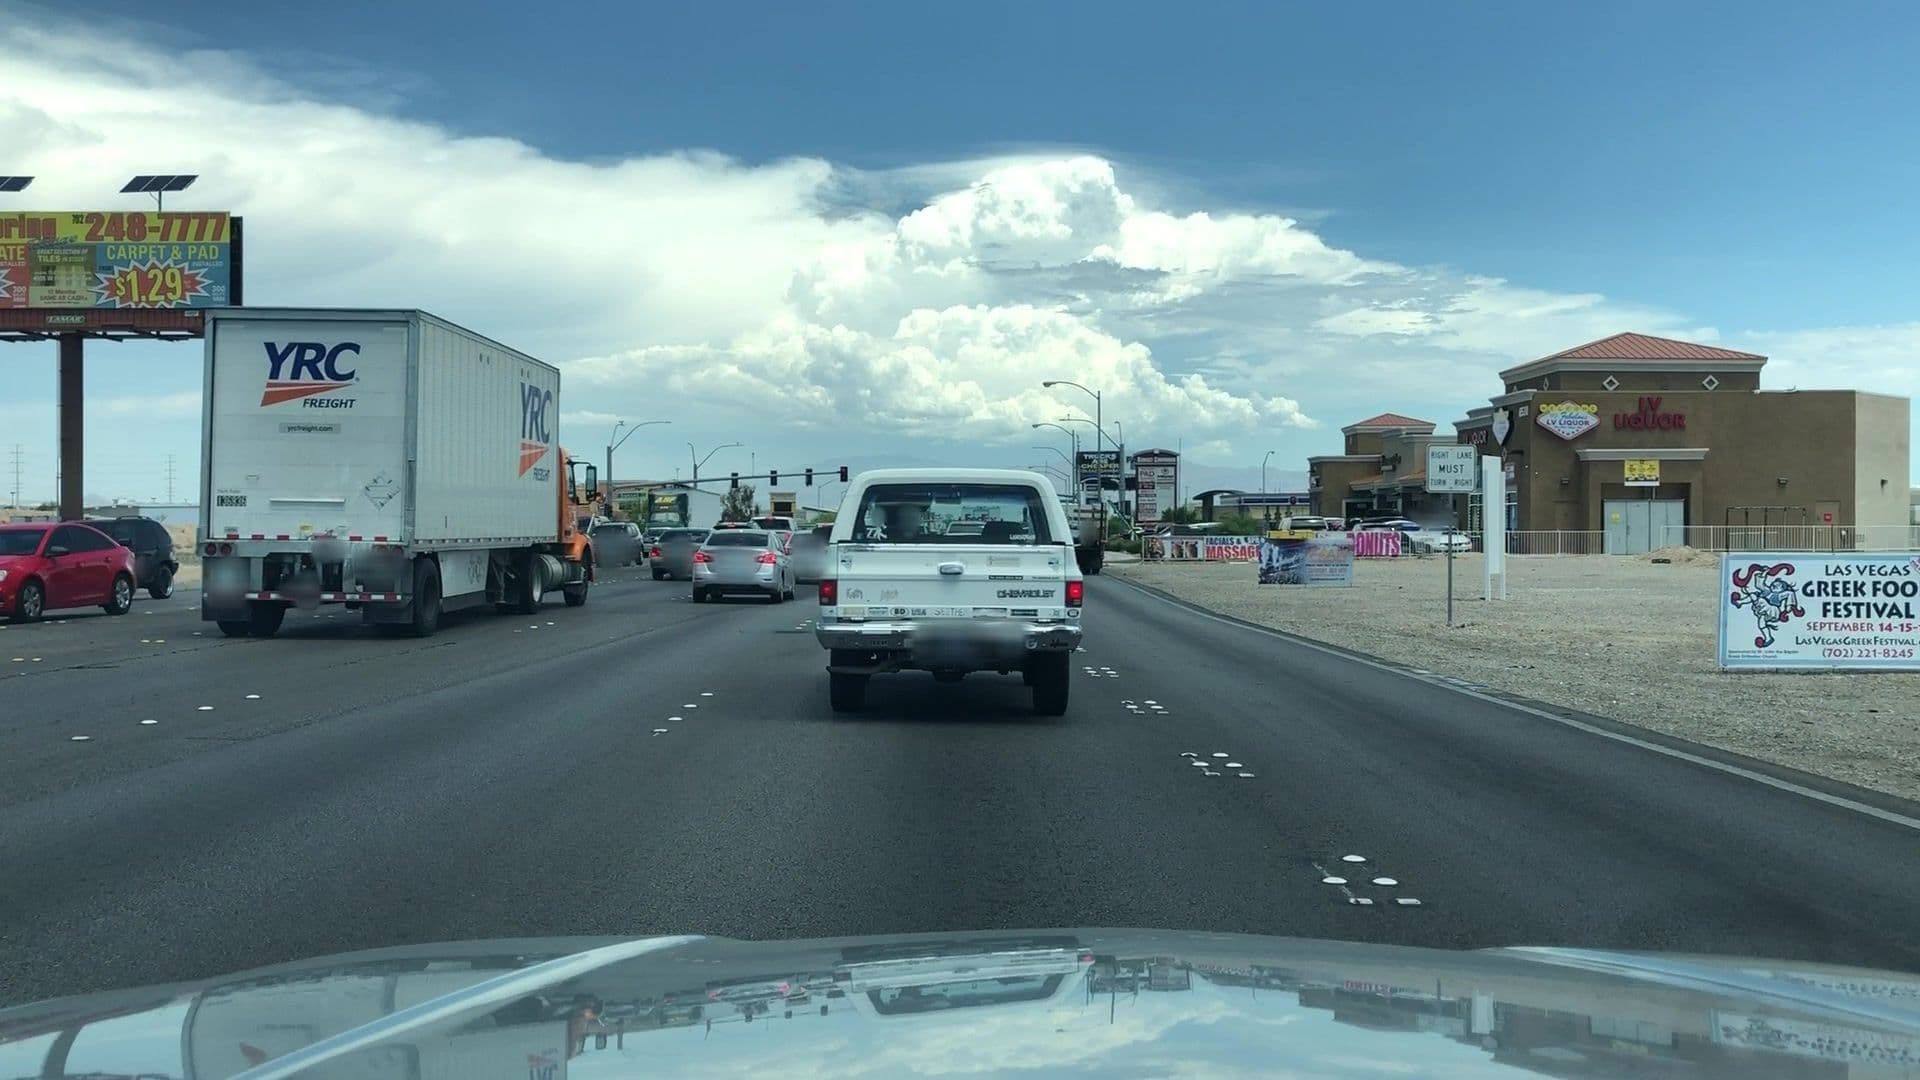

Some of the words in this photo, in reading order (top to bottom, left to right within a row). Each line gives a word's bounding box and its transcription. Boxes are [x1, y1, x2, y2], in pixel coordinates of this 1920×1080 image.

[85, 213, 227, 242] 248-7777
[107, 245, 167, 260] CARPET
[171, 245, 183, 260] &
[188, 245, 219, 260] PAD
[115, 268, 184, 302] $1.29
[263, 341, 362, 382] YRC
[302, 398, 357, 409] FREIGHT
[1638, 397, 1663, 413] LV
[520, 382, 553, 444] YRC
[1614, 412, 1687, 431] LIQUOR
[1430, 451, 1450, 459] RIGHT
[1456, 451, 1473, 459] LANE
[1438, 464, 1465, 474] MUST
[1347, 532, 1400, 557] ONUTS
[1825, 564, 1852, 576] LAS
[1856, 564, 1911, 576] VEGAS
[996, 589, 1056, 599] CHEVROLET
[1801, 580, 1866, 598] GREEK
[1872, 580, 1919, 598] FOO
[1822, 601, 1916, 619] FESTIVAL
[1806, 622, 1874, 632] SEPTEMBER
[1878, 622, 1920, 632] 14-15-
[1822, 648, 1853, 659] (702)
[1857, 648, 1914, 659] 221-8245
